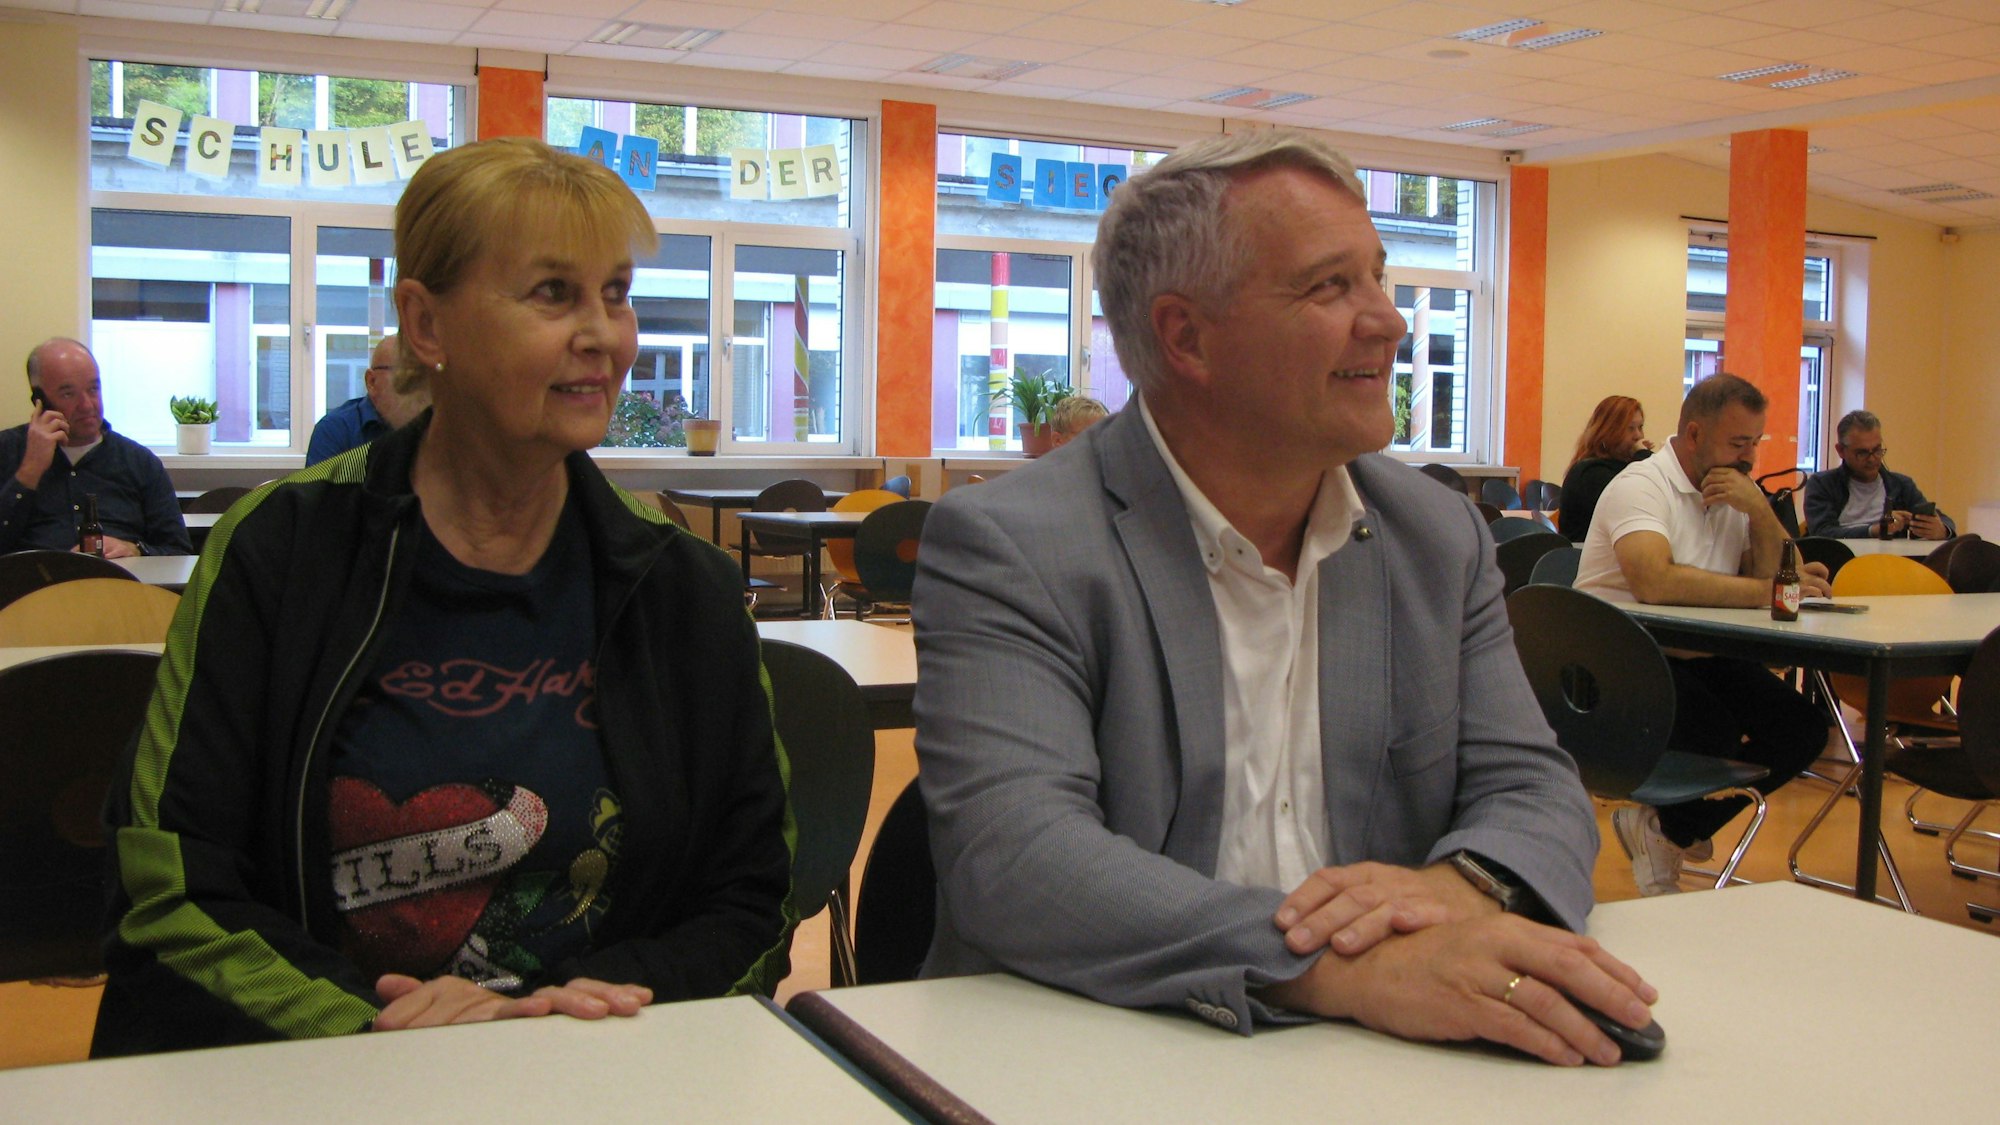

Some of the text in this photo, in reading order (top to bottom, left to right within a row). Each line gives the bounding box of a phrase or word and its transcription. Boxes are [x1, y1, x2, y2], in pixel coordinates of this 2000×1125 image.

[140, 117, 425, 172] SCHULE
[587, 140, 652, 178] AN
[739, 157, 834, 186] DER
[380, 660, 485, 702] Ed
[332, 822, 503, 905] ILLS
